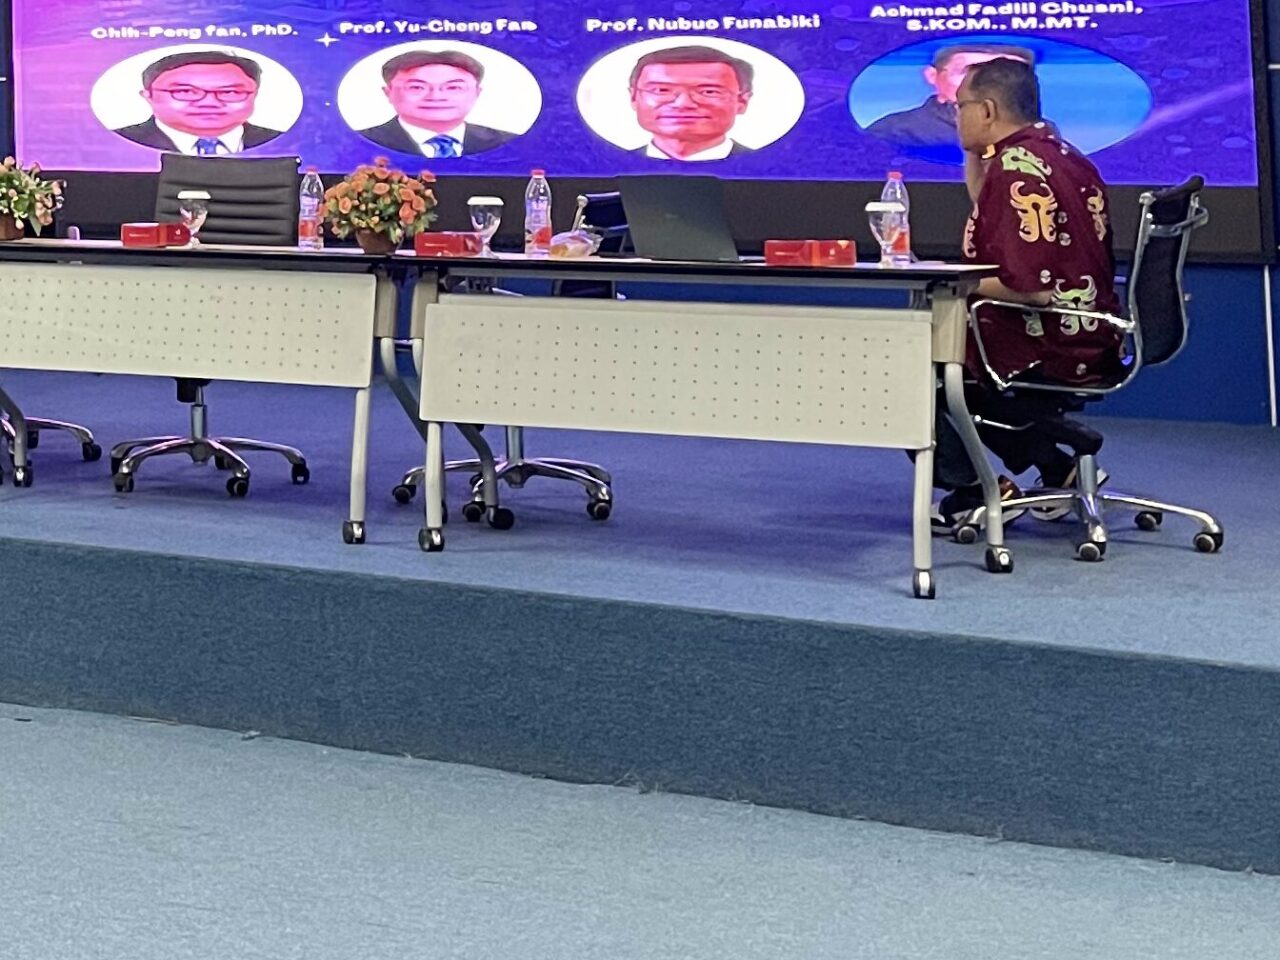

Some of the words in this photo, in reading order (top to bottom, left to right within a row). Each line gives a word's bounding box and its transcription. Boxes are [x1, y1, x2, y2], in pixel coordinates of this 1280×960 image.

[251, 23, 299, 36] PhD.
[339, 21, 391, 34] Prof.
[586, 18, 643, 32] Prof.
[722, 14, 821, 29] Funabiki
